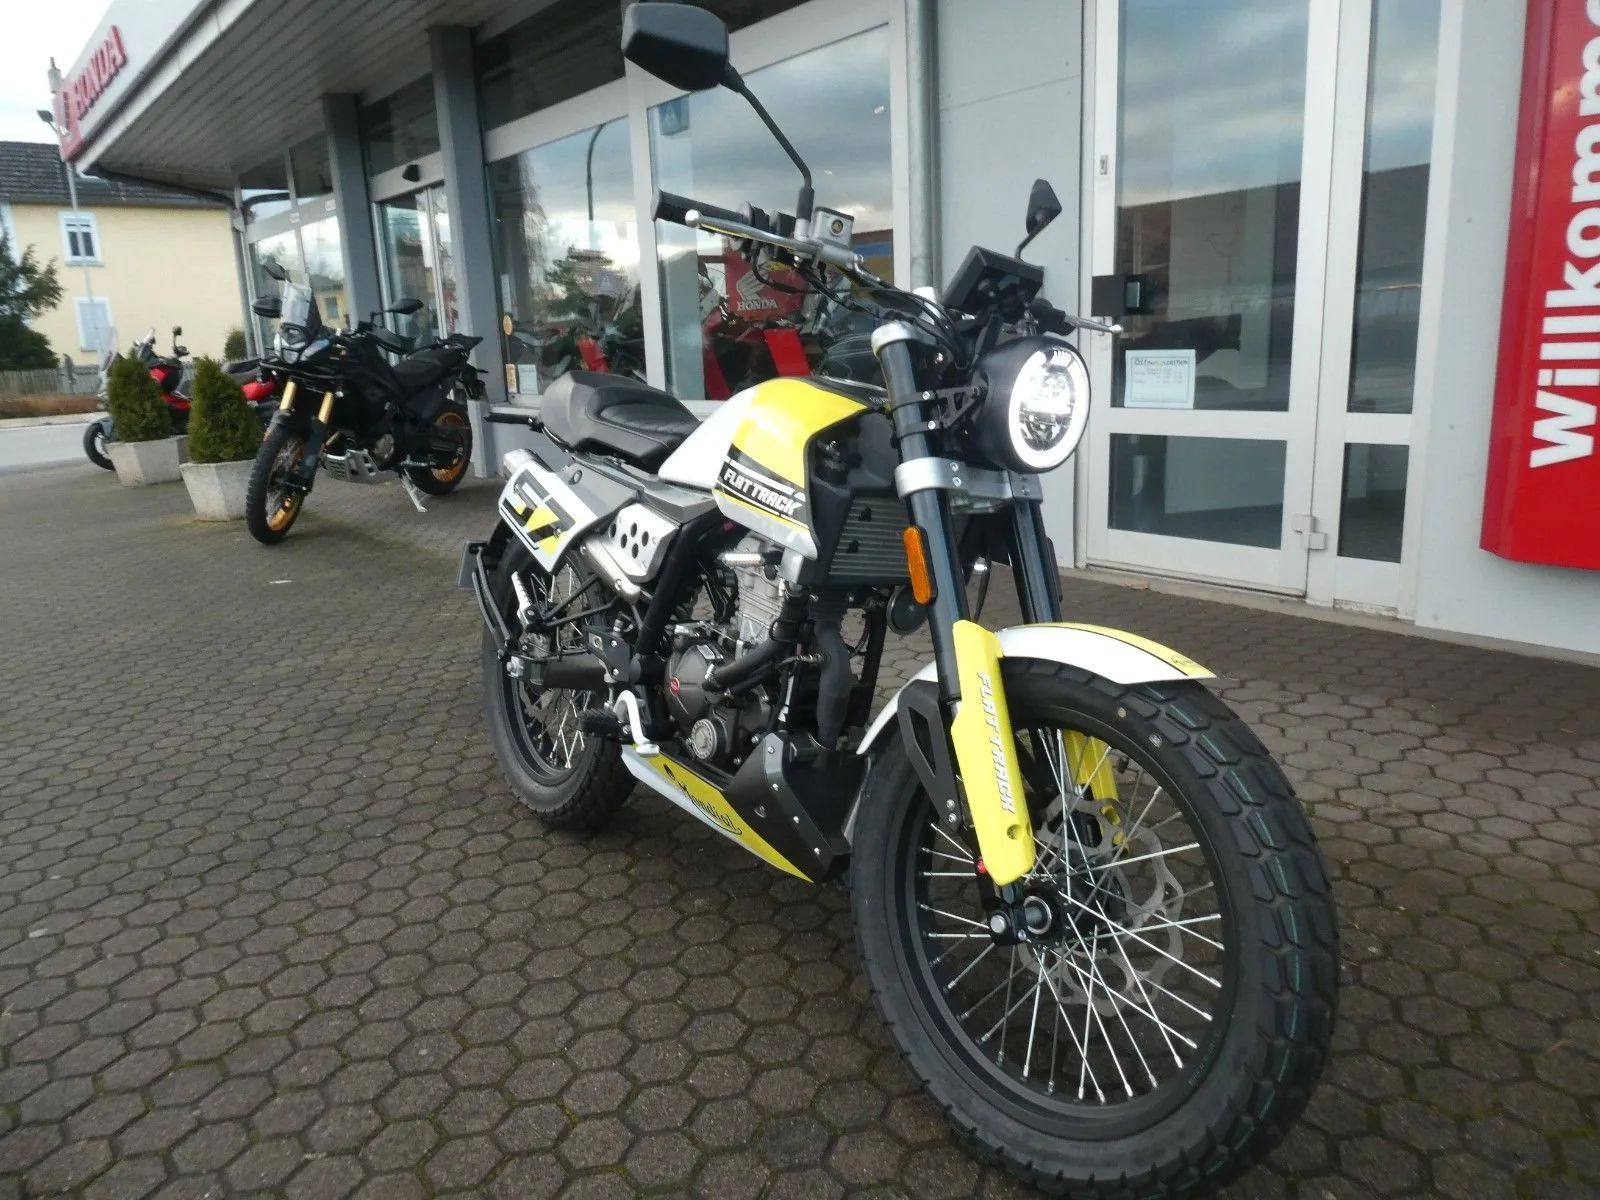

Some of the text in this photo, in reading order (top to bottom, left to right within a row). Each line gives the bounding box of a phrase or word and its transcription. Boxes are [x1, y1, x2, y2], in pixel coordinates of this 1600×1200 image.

[74, 26, 127, 121] HONDA
[1529, 0, 1600, 468] Willkom
[738, 299, 778, 312] HONDA
[722, 467, 802, 517] FLAT TRACK
[977, 672, 1014, 816] FLAT TRACK
